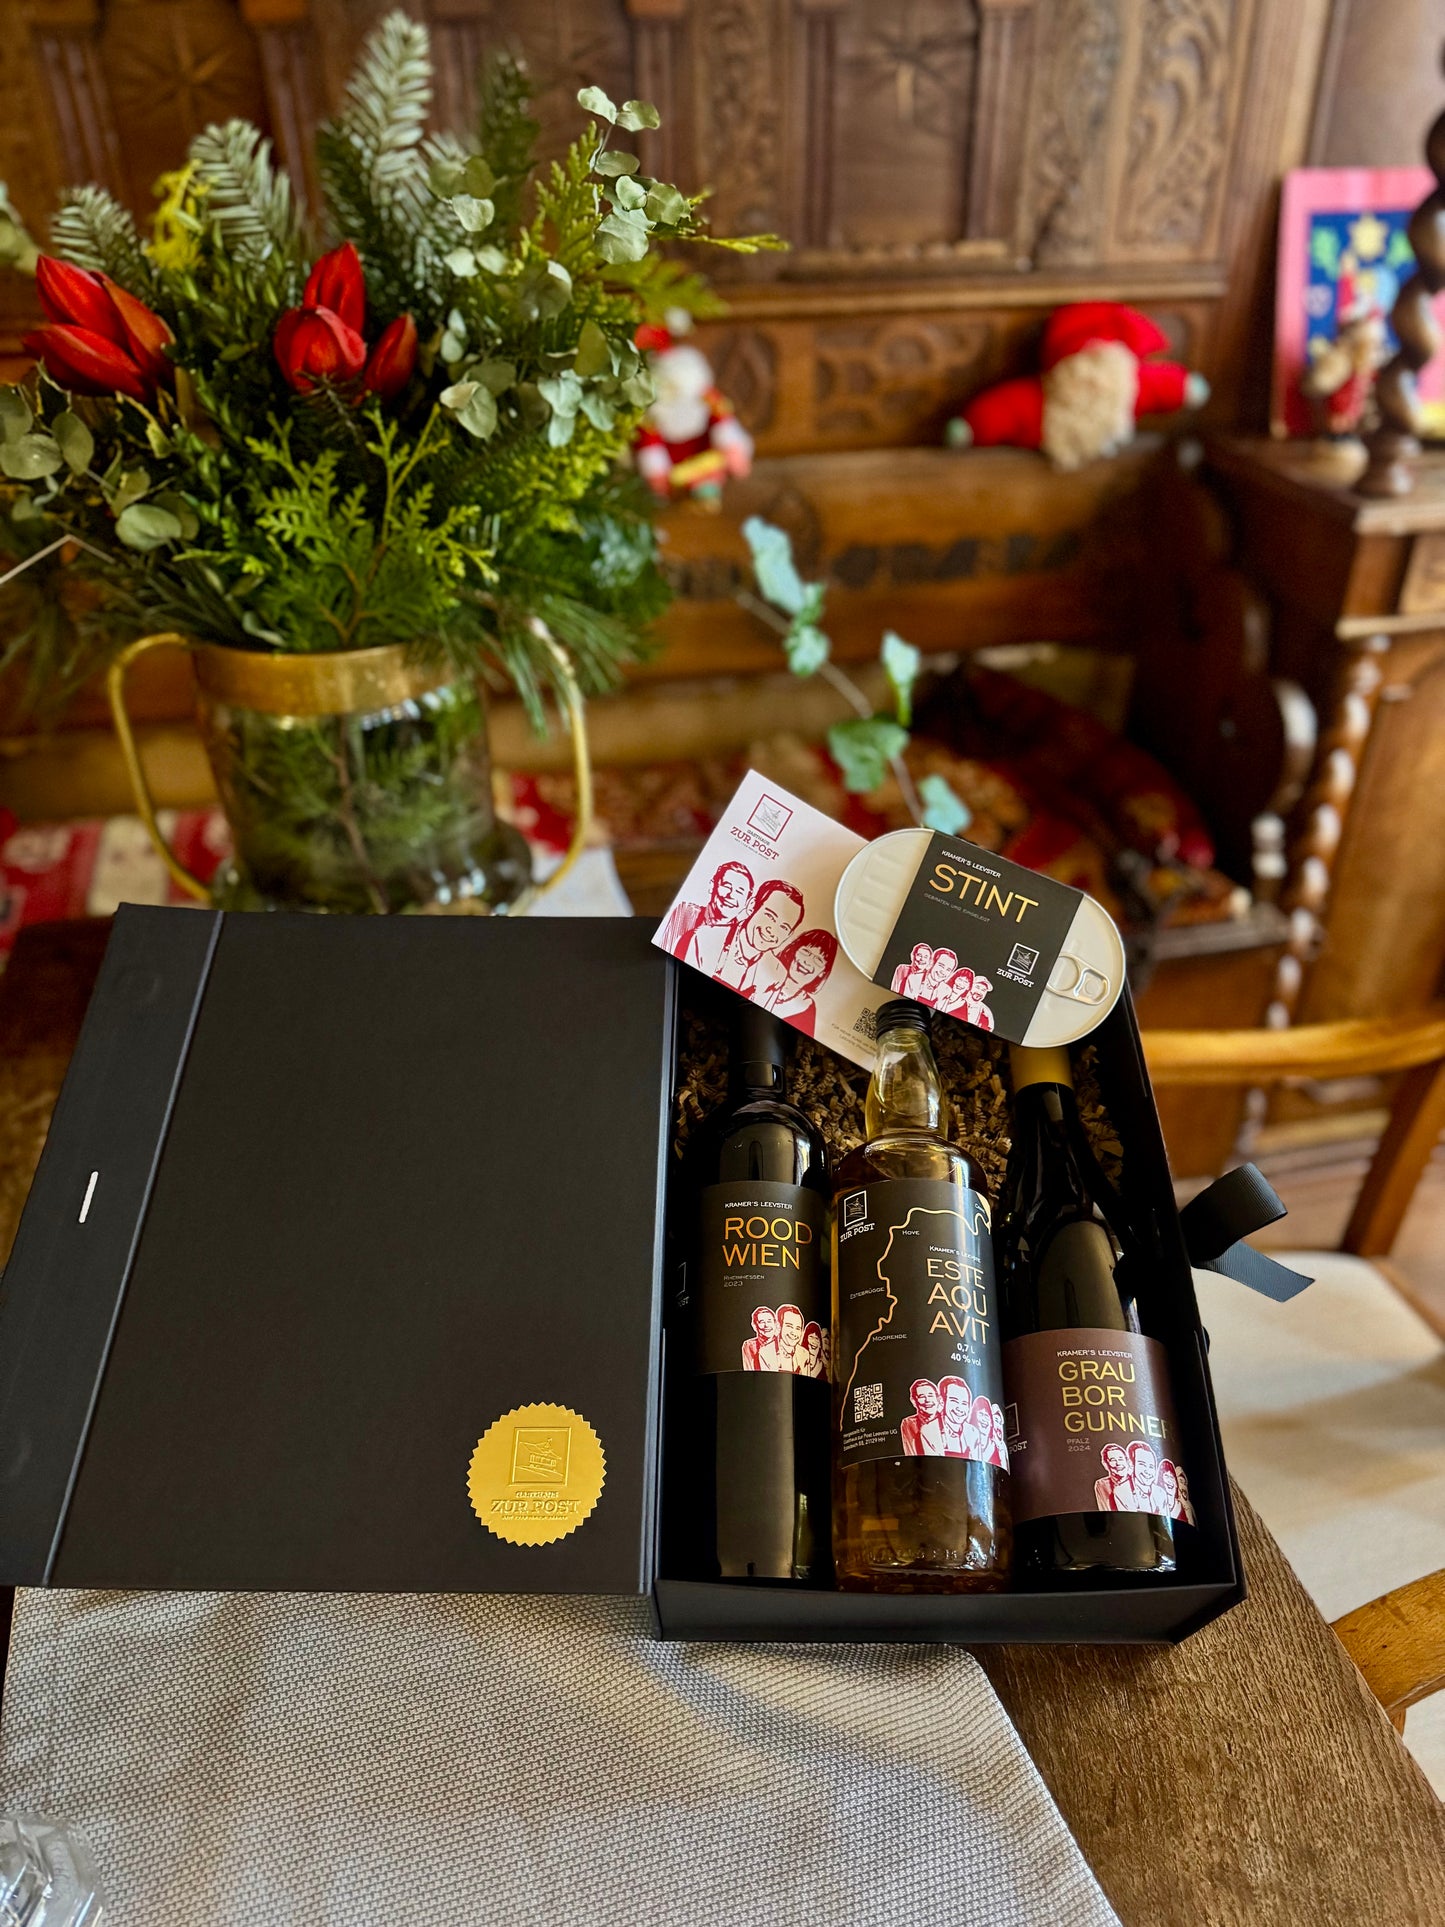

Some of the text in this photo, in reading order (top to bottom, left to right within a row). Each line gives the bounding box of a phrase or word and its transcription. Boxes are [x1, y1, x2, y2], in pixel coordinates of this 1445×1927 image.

[730, 826, 751, 844] ZUR
[751, 840, 780, 860] POST
[941, 850, 972, 866] KRAMER'S
[928, 863, 1039, 923] STINT
[996, 968, 1013, 980] ZUR
[1013, 975, 1035, 988] POST
[724, 1201, 793, 1210] KRAMER'S LEEVSTER
[724, 1216, 813, 1245] ROOD
[840, 1230, 853, 1243] ZUR
[853, 1222, 875, 1236] POST
[722, 1243, 800, 1270] WIEN
[927, 1258, 986, 1290] ESTE
[927, 1282, 987, 1316] AQU
[928, 1310, 990, 1345] AVIT
[957, 1342, 969, 1352] 0,7
[1057, 1349, 1133, 1359] KRAMER'S LEEVSTER
[950, 1352, 981, 1366] 40 % vol
[1058, 1361, 1136, 1383] GRAU
[1062, 1385, 1126, 1407] BOR
[491, 1500, 581, 1514] ZUR POST
